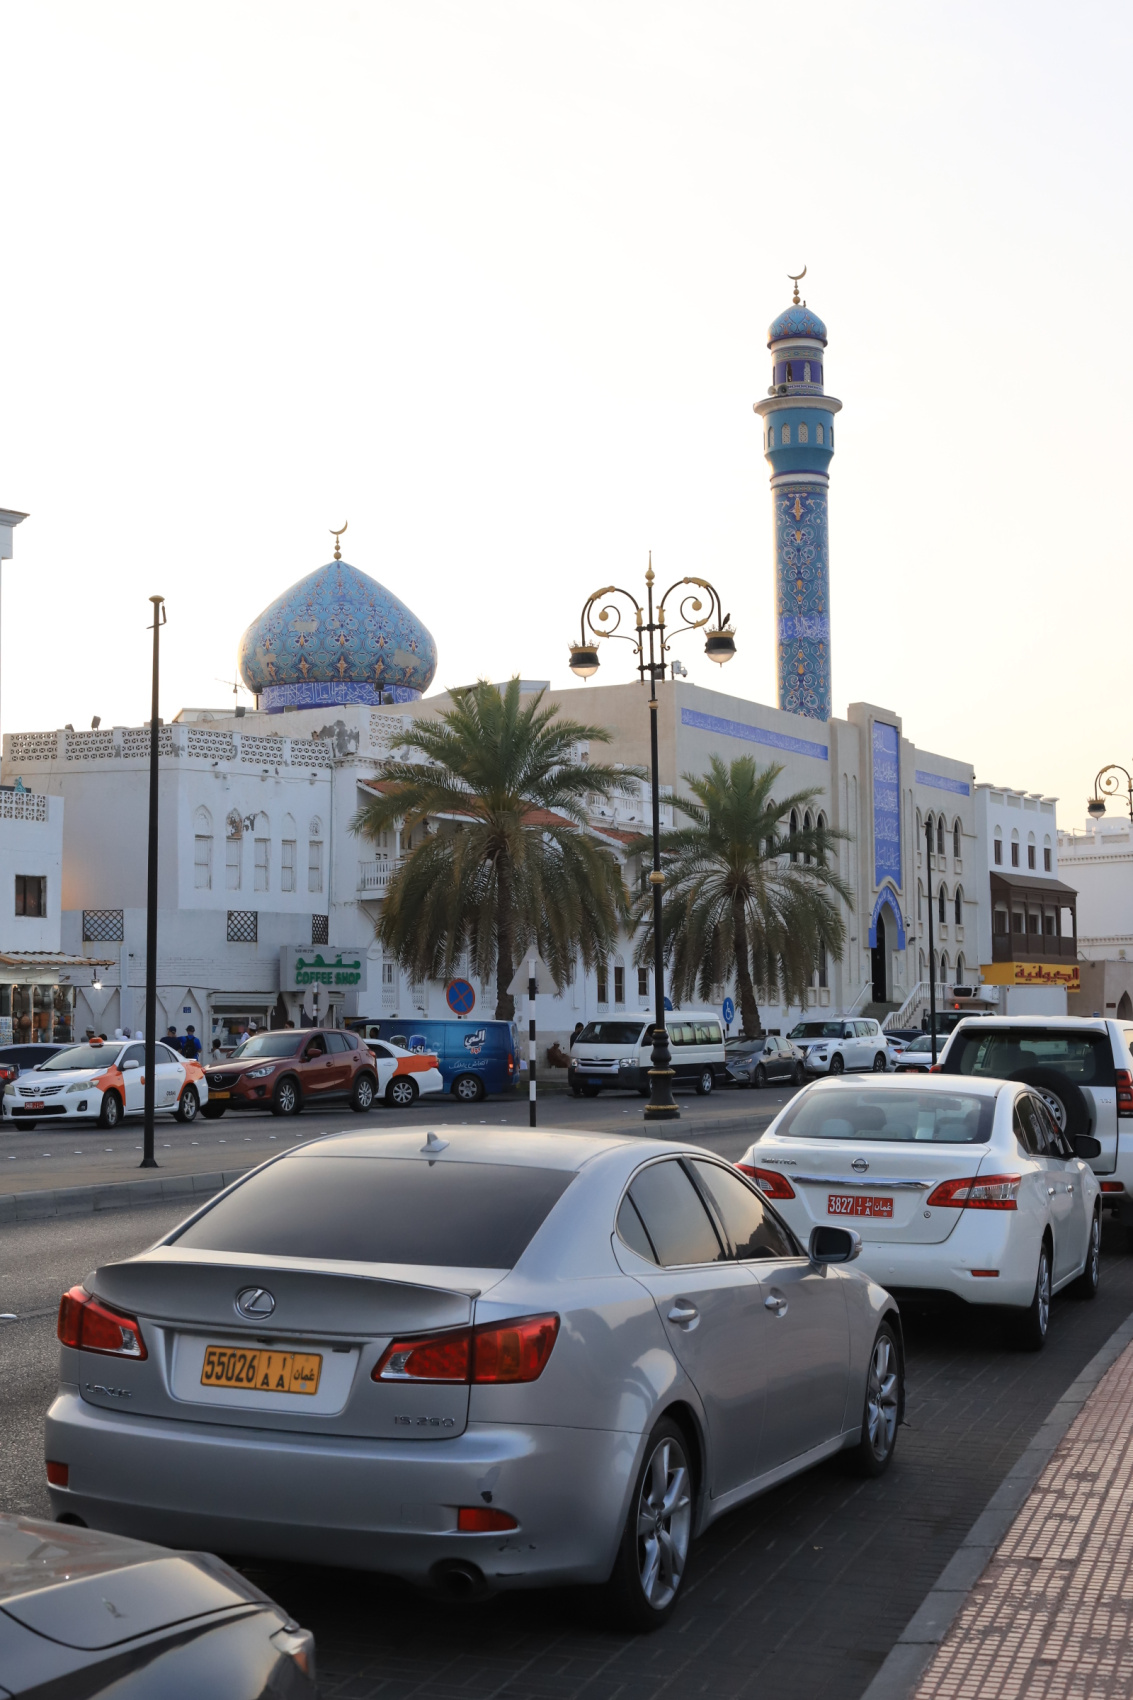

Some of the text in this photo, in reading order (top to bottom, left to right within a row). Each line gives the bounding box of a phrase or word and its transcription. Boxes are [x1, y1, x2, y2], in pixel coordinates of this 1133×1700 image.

[295, 971, 362, 985] COFFEE SHOP
[761, 1157, 798, 1166] SENTRA
[829, 1196, 854, 1213] 3827
[204, 1351, 257, 1383] 55026
[85, 1382, 132, 1398] LEXUS
[394, 1415, 455, 1427] IS 250
